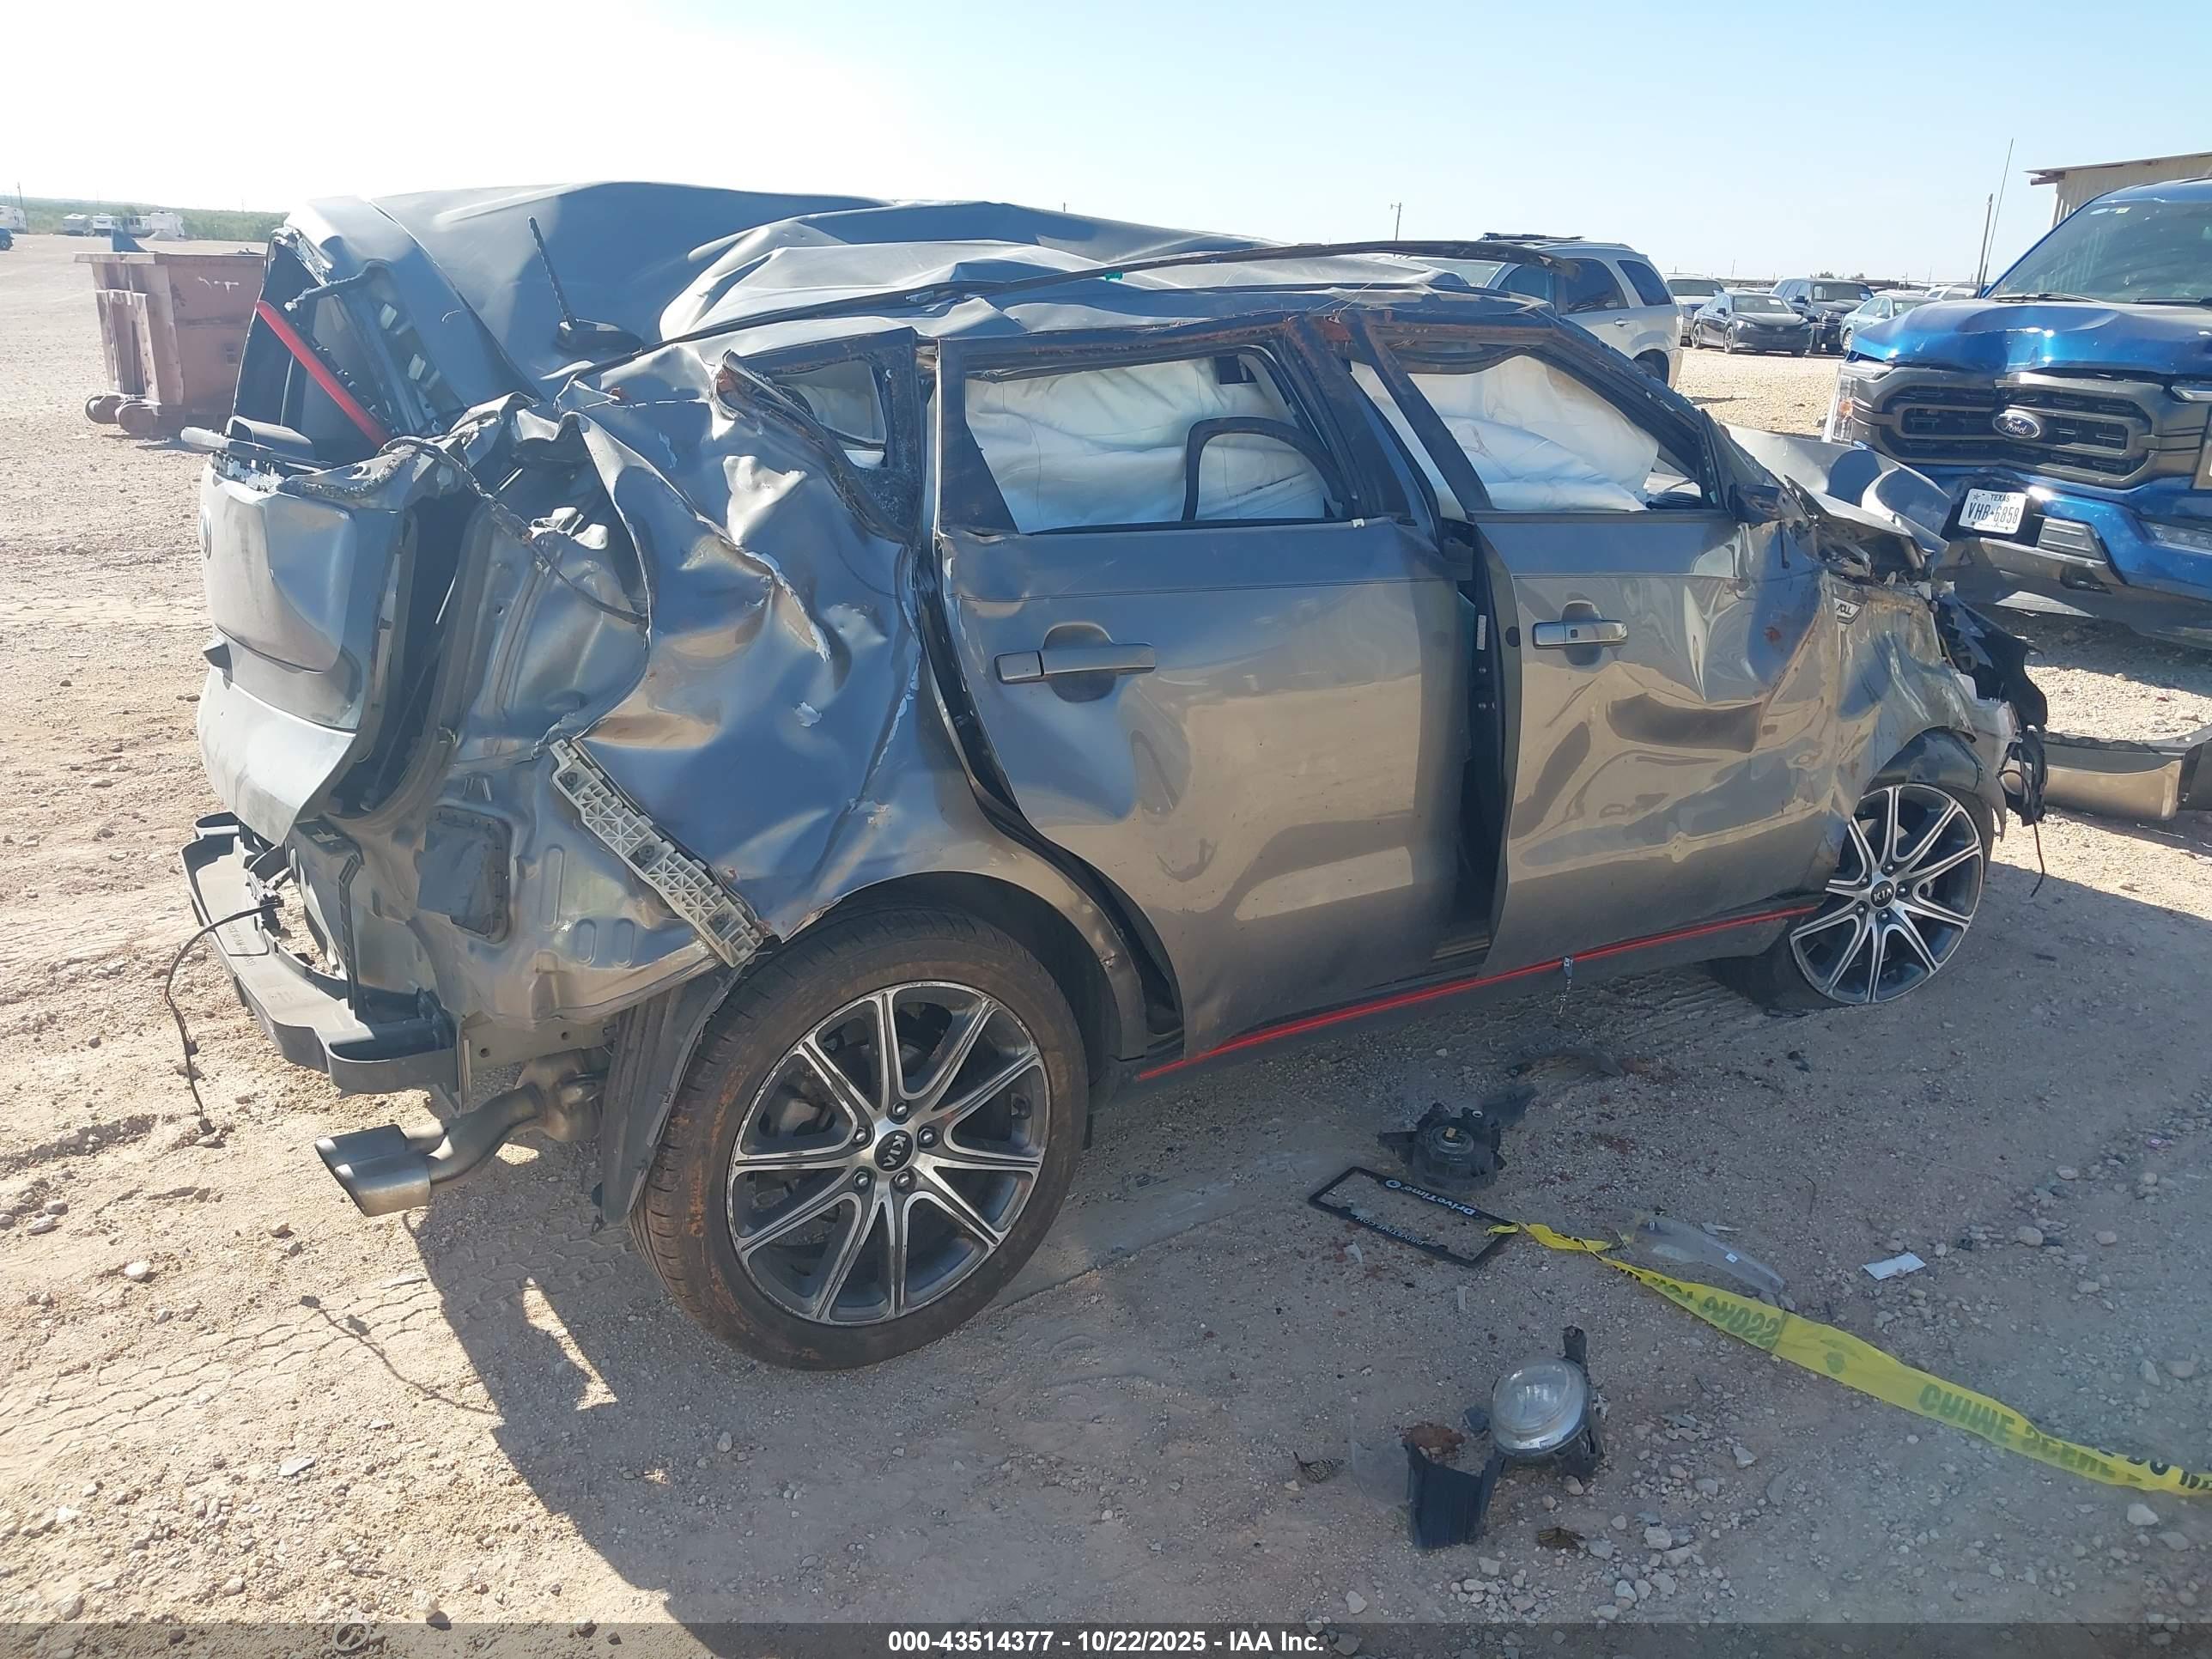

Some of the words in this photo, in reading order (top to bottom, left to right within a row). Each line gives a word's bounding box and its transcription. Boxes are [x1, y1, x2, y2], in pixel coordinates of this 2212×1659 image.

[1990, 494, 2010, 502] TEXAS
[1967, 502, 1991, 520] VHB
[1993, 505, 2020, 524] 6858
[1873, 888, 1893, 902] KIA
[883, 1134, 907, 1167] KIA
[1403, 1185, 1476, 1216] DriveTime
[1355, 1215, 1425, 1245] DRIVETIME.COM
